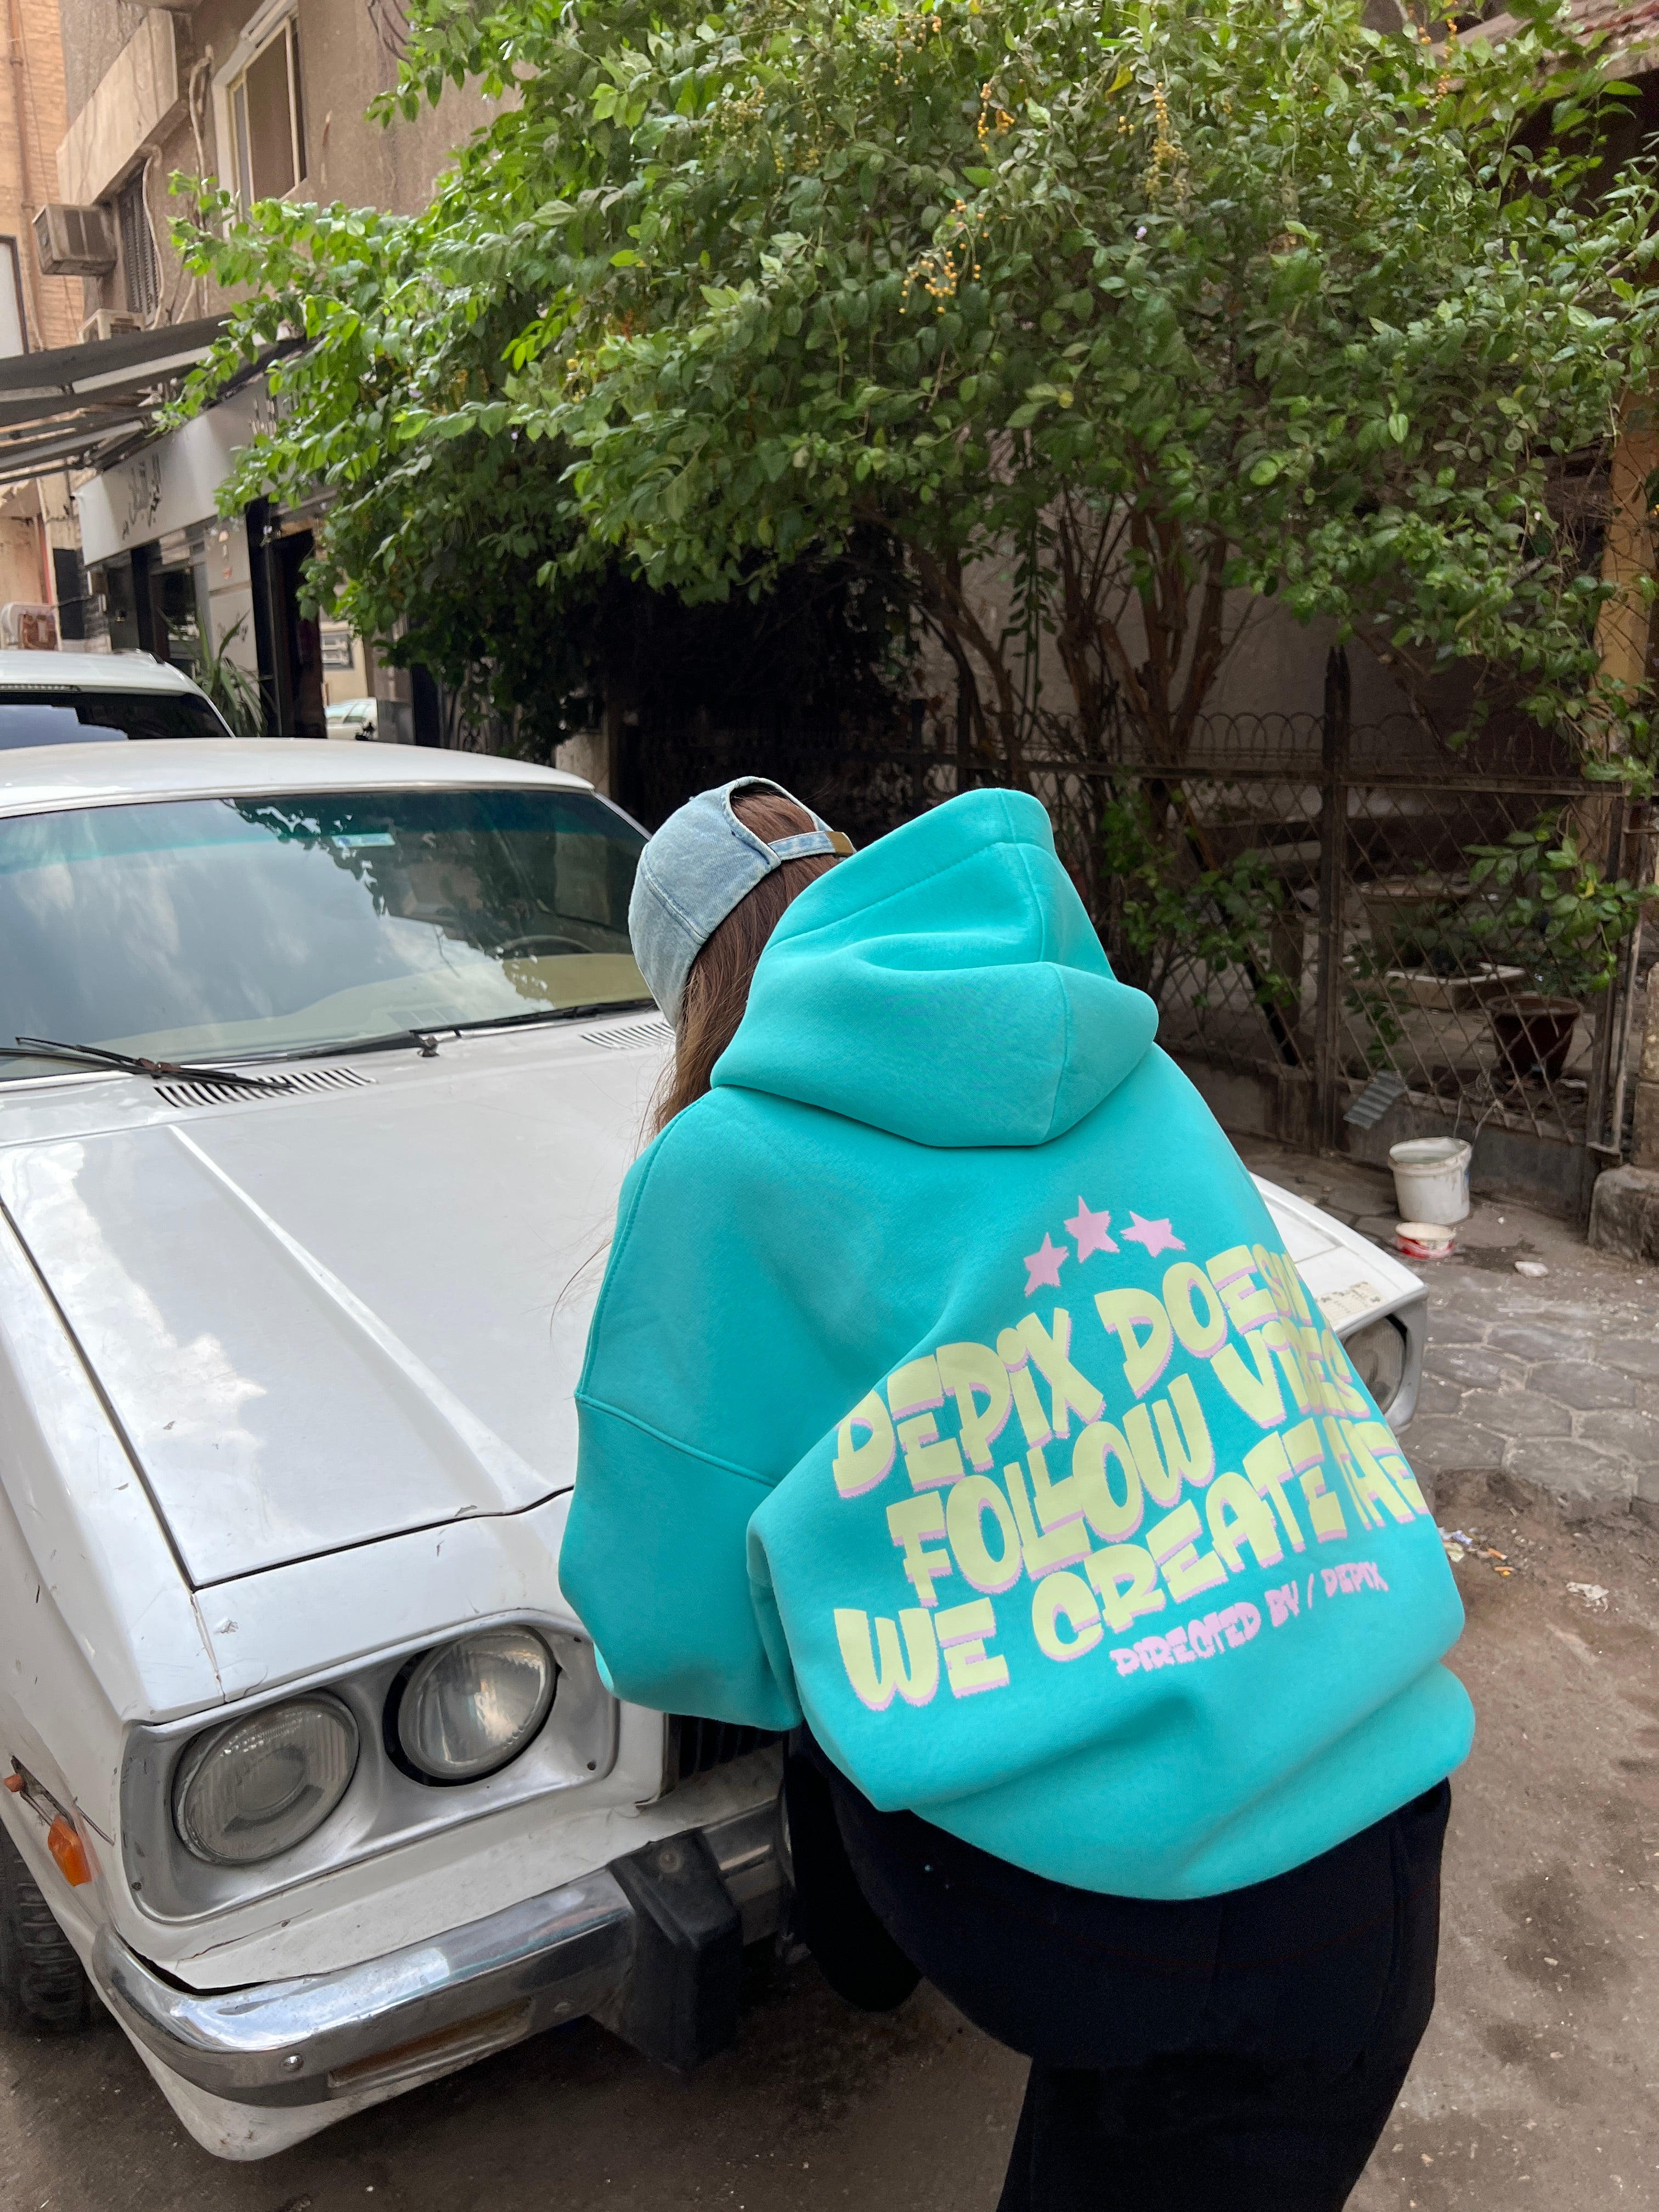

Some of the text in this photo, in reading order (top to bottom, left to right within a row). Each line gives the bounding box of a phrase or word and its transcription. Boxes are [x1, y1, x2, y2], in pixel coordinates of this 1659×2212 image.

[833, 1307, 1106, 1499] DEPIX
[887, 1318, 1370, 1607] FOLLOW VIBES
[833, 1597, 1009, 1711] WE
[1032, 1418, 1347, 1662] CREATE
[1109, 1602, 1262, 1677] DIRECTED
[1264, 1581, 1300, 1627] BY
[1320, 1561, 1390, 1598] DEPIX
